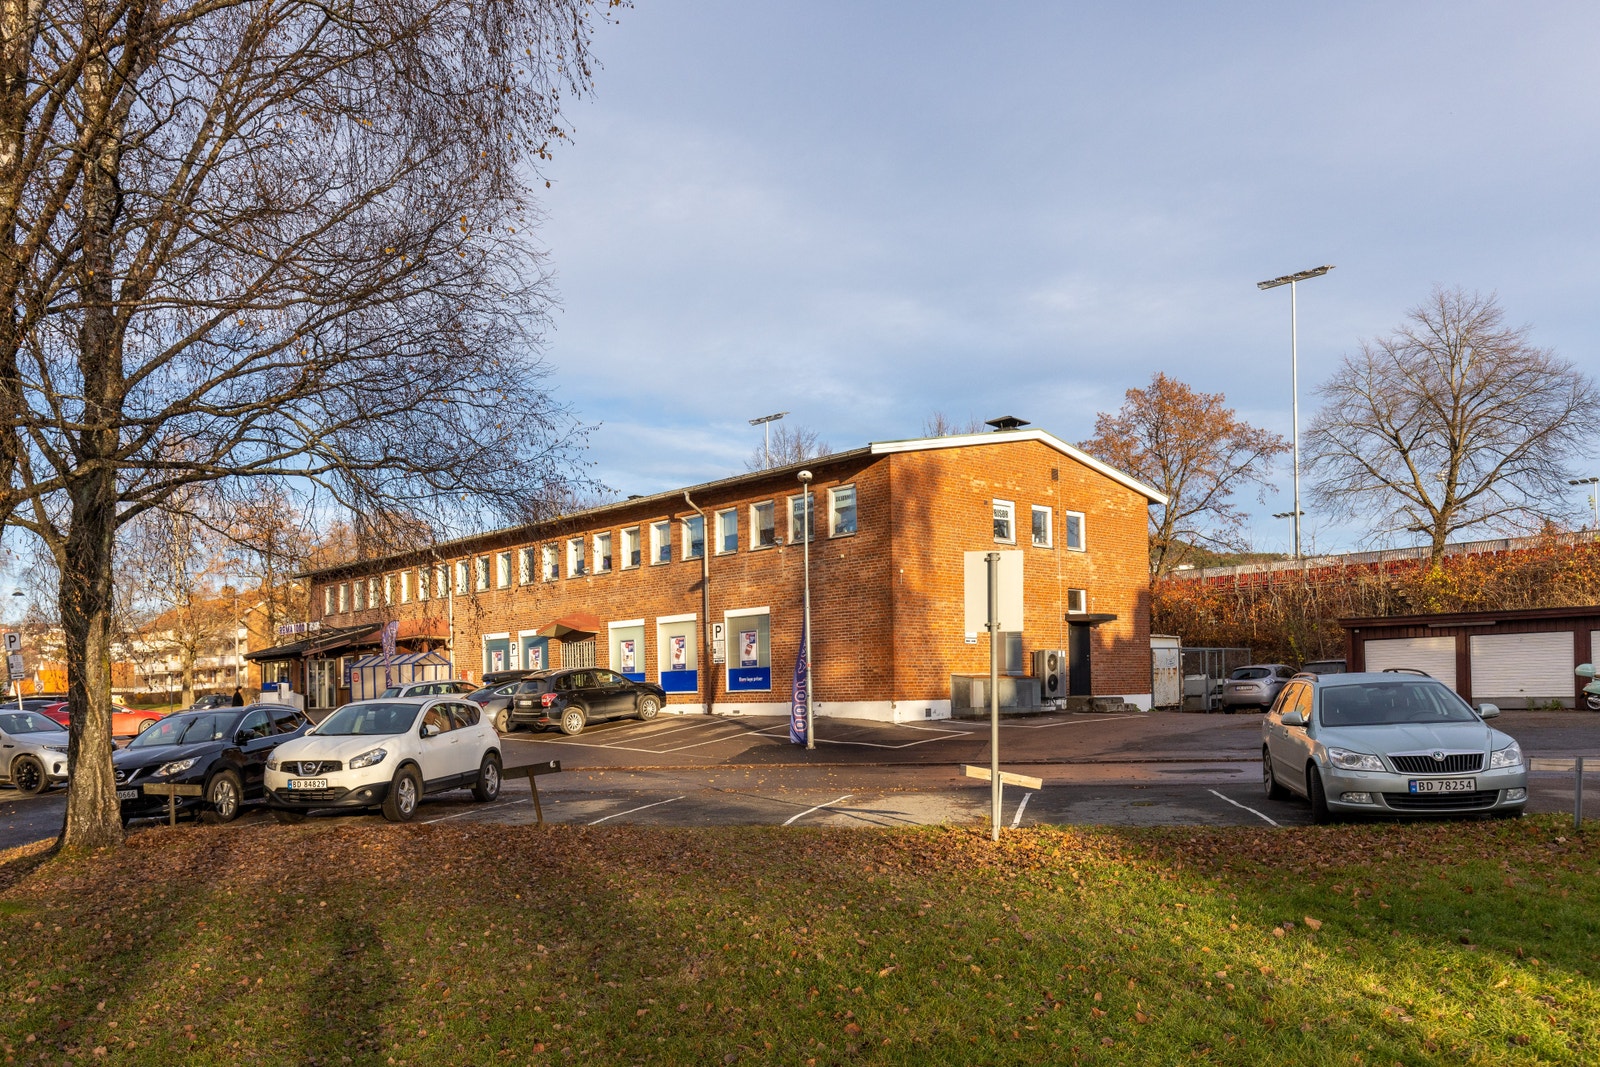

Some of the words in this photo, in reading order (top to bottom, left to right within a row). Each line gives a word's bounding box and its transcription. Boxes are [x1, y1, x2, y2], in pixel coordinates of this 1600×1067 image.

[715, 625, 722, 639] P
[8, 635, 17, 649] P
[511, 643, 517, 655] P
[793, 679, 807, 732] 1000
[292, 780, 302, 789] BD
[303, 780, 326, 789] 84829
[1418, 781, 1433, 791] BD
[1438, 780, 1472, 791] 78254
